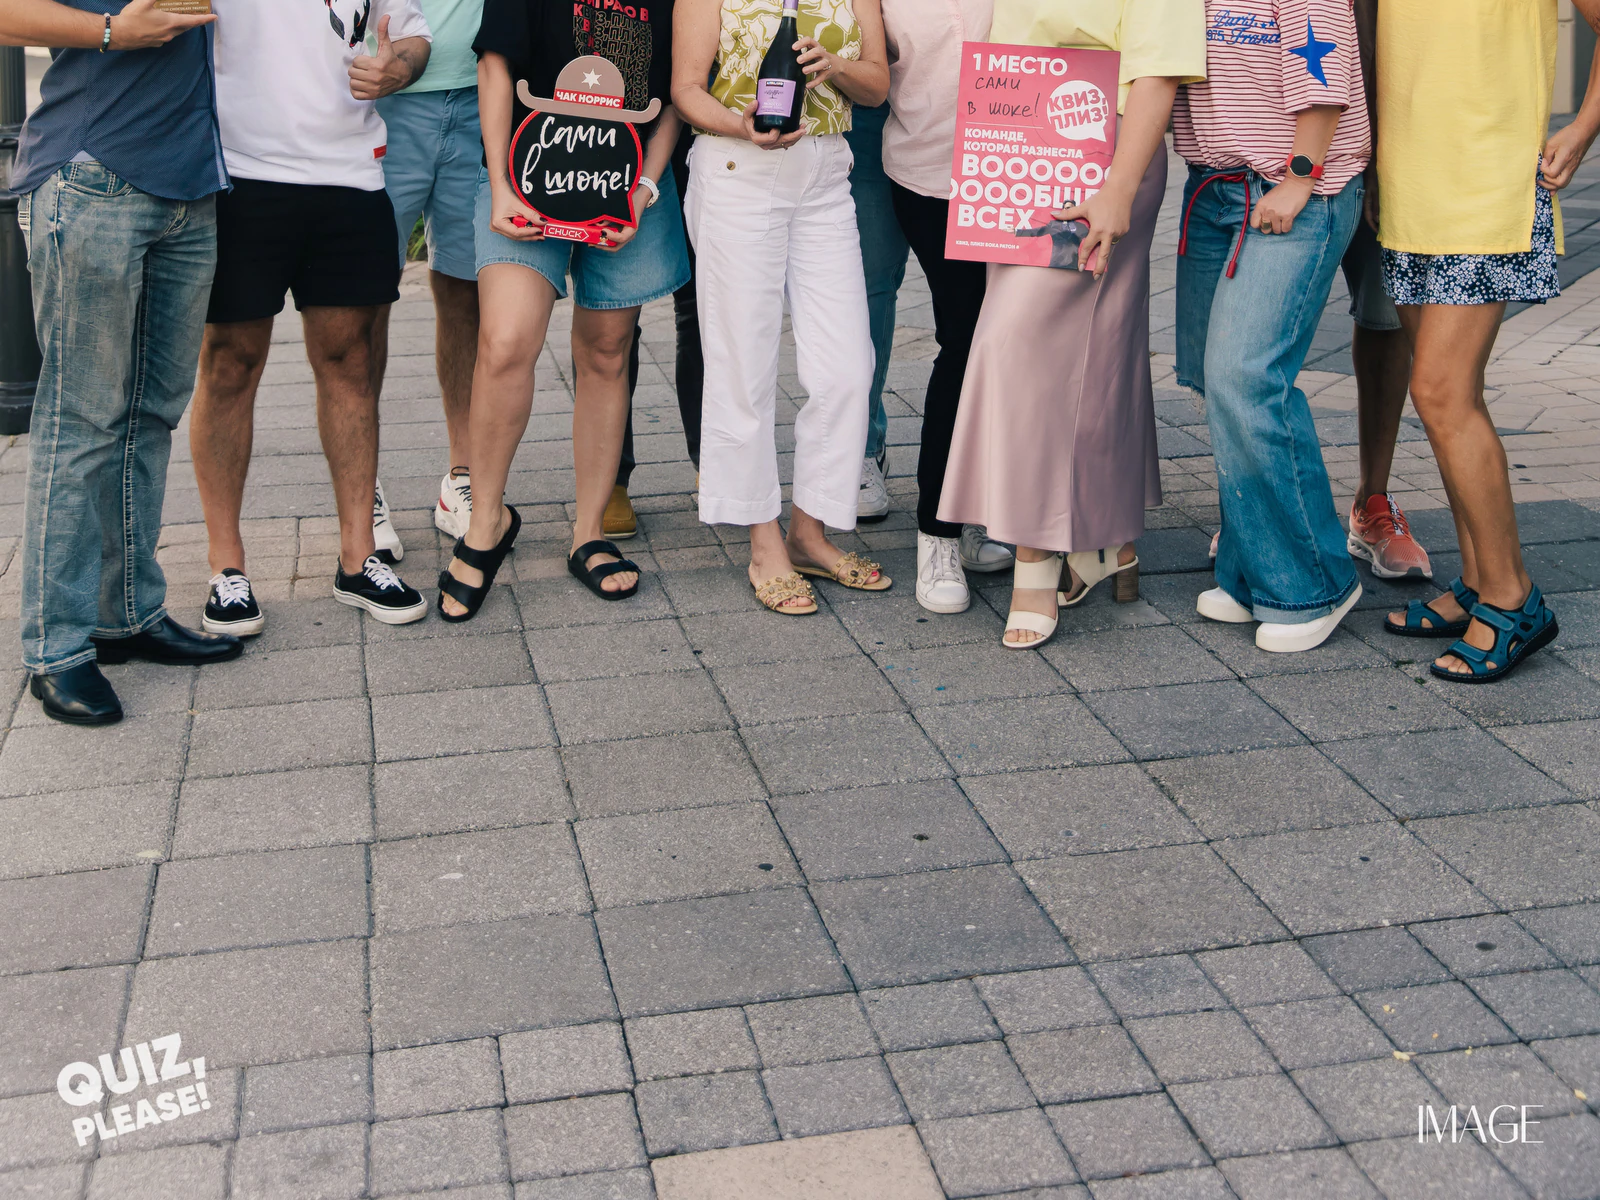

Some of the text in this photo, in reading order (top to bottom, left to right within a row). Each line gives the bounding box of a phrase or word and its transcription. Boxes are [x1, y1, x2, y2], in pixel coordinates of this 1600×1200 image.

[972, 53, 1068, 76] 1 МЕСТО
[556, 91, 621, 108] ЧАК НОРРИС
[1048, 88, 1107, 113] КВИЗ,
[1049, 106, 1108, 131] ПЛИЗ!
[540, 115, 617, 153] Сами
[964, 127, 1027, 144] КОМАНДЕ,
[963, 140, 1084, 159] КОТОРАЯ РАЗНЕСЛА
[521, 143, 631, 199] в шоке!
[961, 153, 1112, 186] ВООООО
[957, 204, 1035, 230] ВСЕХ
[548, 226, 583, 239] CHUCK
